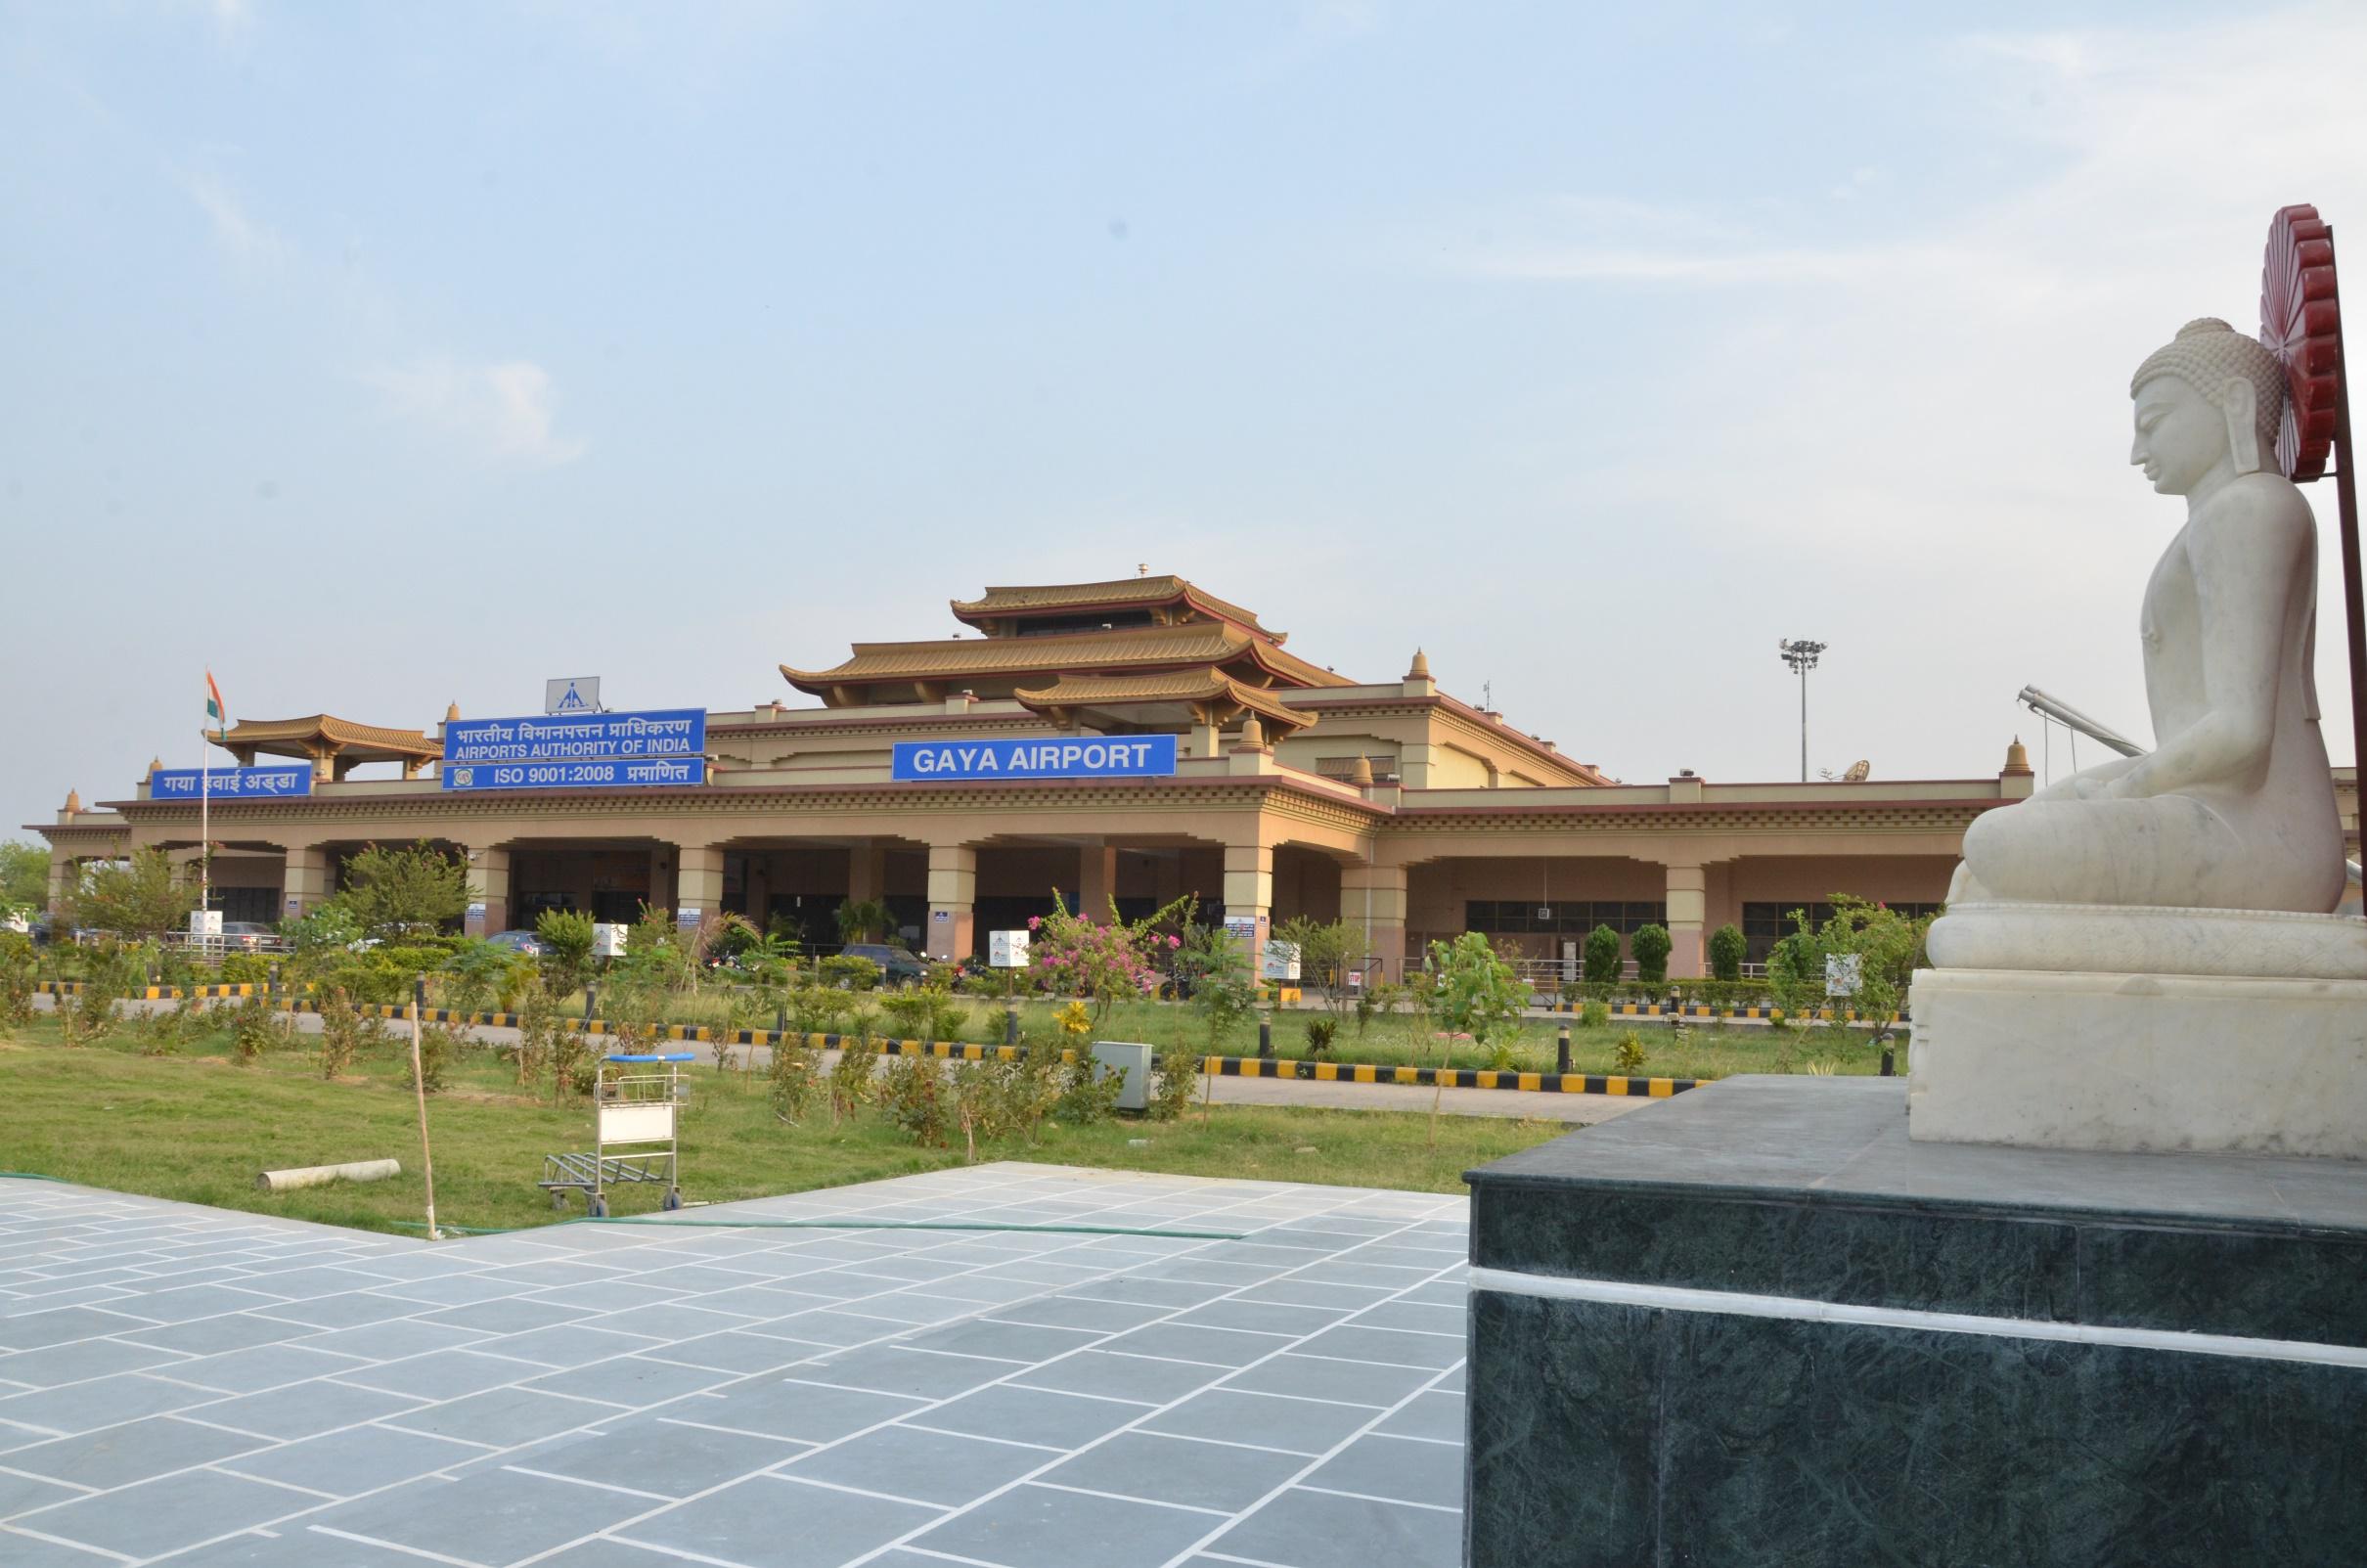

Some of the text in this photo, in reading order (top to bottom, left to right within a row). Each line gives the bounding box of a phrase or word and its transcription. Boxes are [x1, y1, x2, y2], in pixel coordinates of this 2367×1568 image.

[456, 717, 692, 743] भारतीय विमानपत्तन प्राधिकरण
[456, 738, 691, 760] AIRPORTS AUTHORITY OF INDIA
[914, 743, 1152, 772] GAYA AIRPORT
[163, 770, 297, 794] गया हवाई अड्डा
[495, 762, 690, 784] ISO 9001:2008 प्रमाणित
